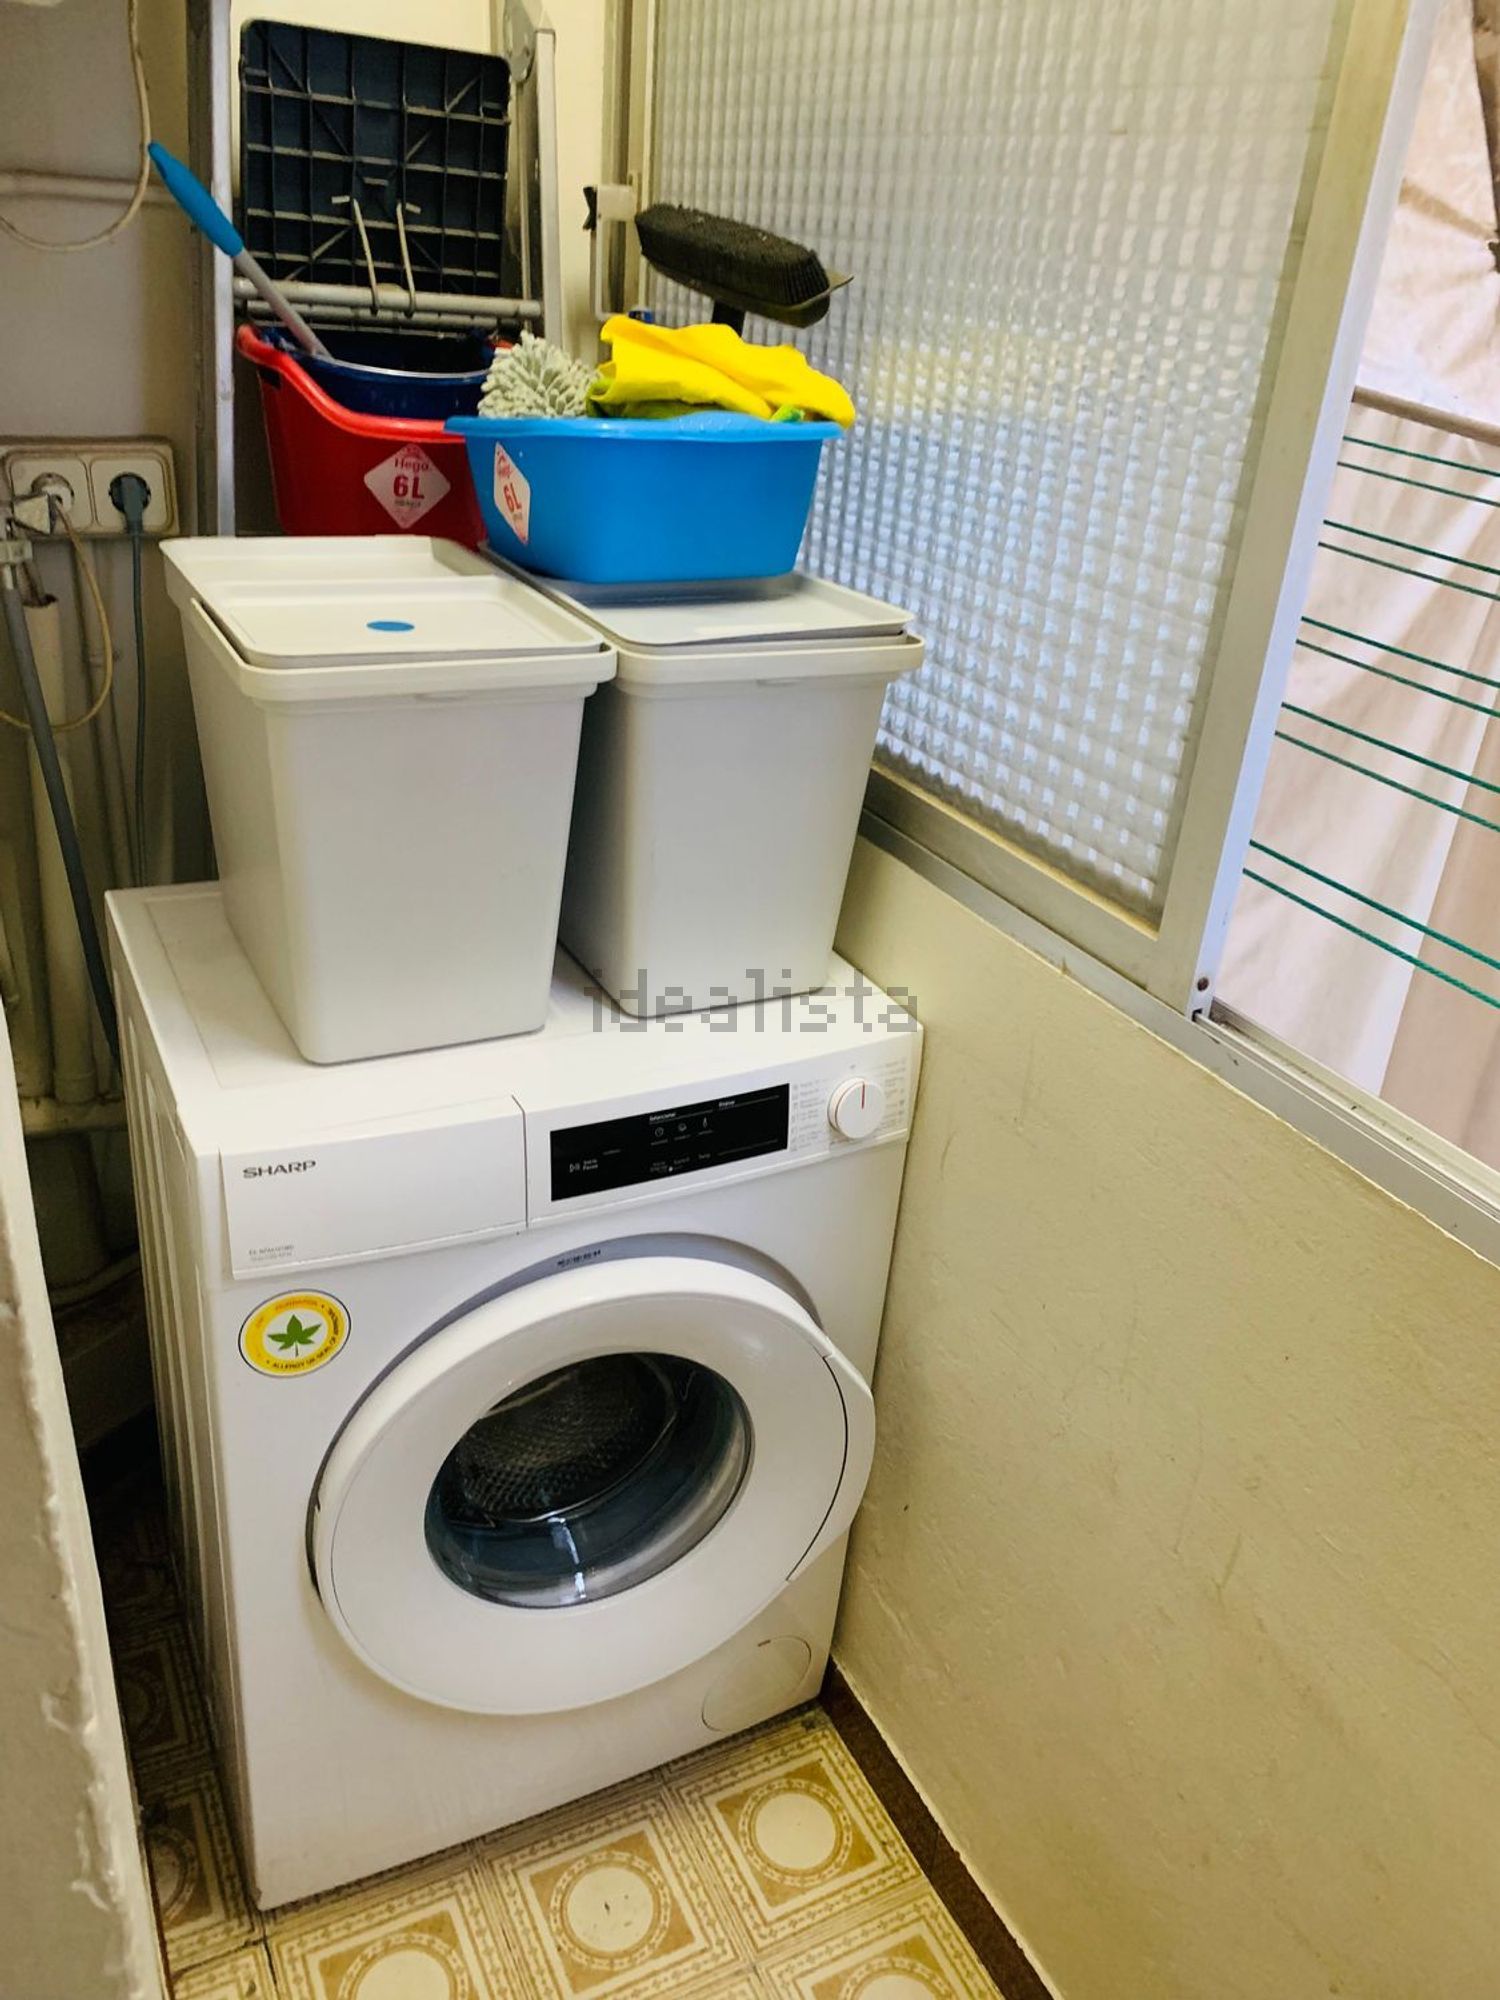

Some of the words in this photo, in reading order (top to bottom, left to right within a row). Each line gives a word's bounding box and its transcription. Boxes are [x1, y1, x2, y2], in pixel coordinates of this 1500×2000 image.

[393, 475, 425, 499] 6L
[503, 482, 523, 513] 6L
[243, 1160, 316, 1178] SHARP
